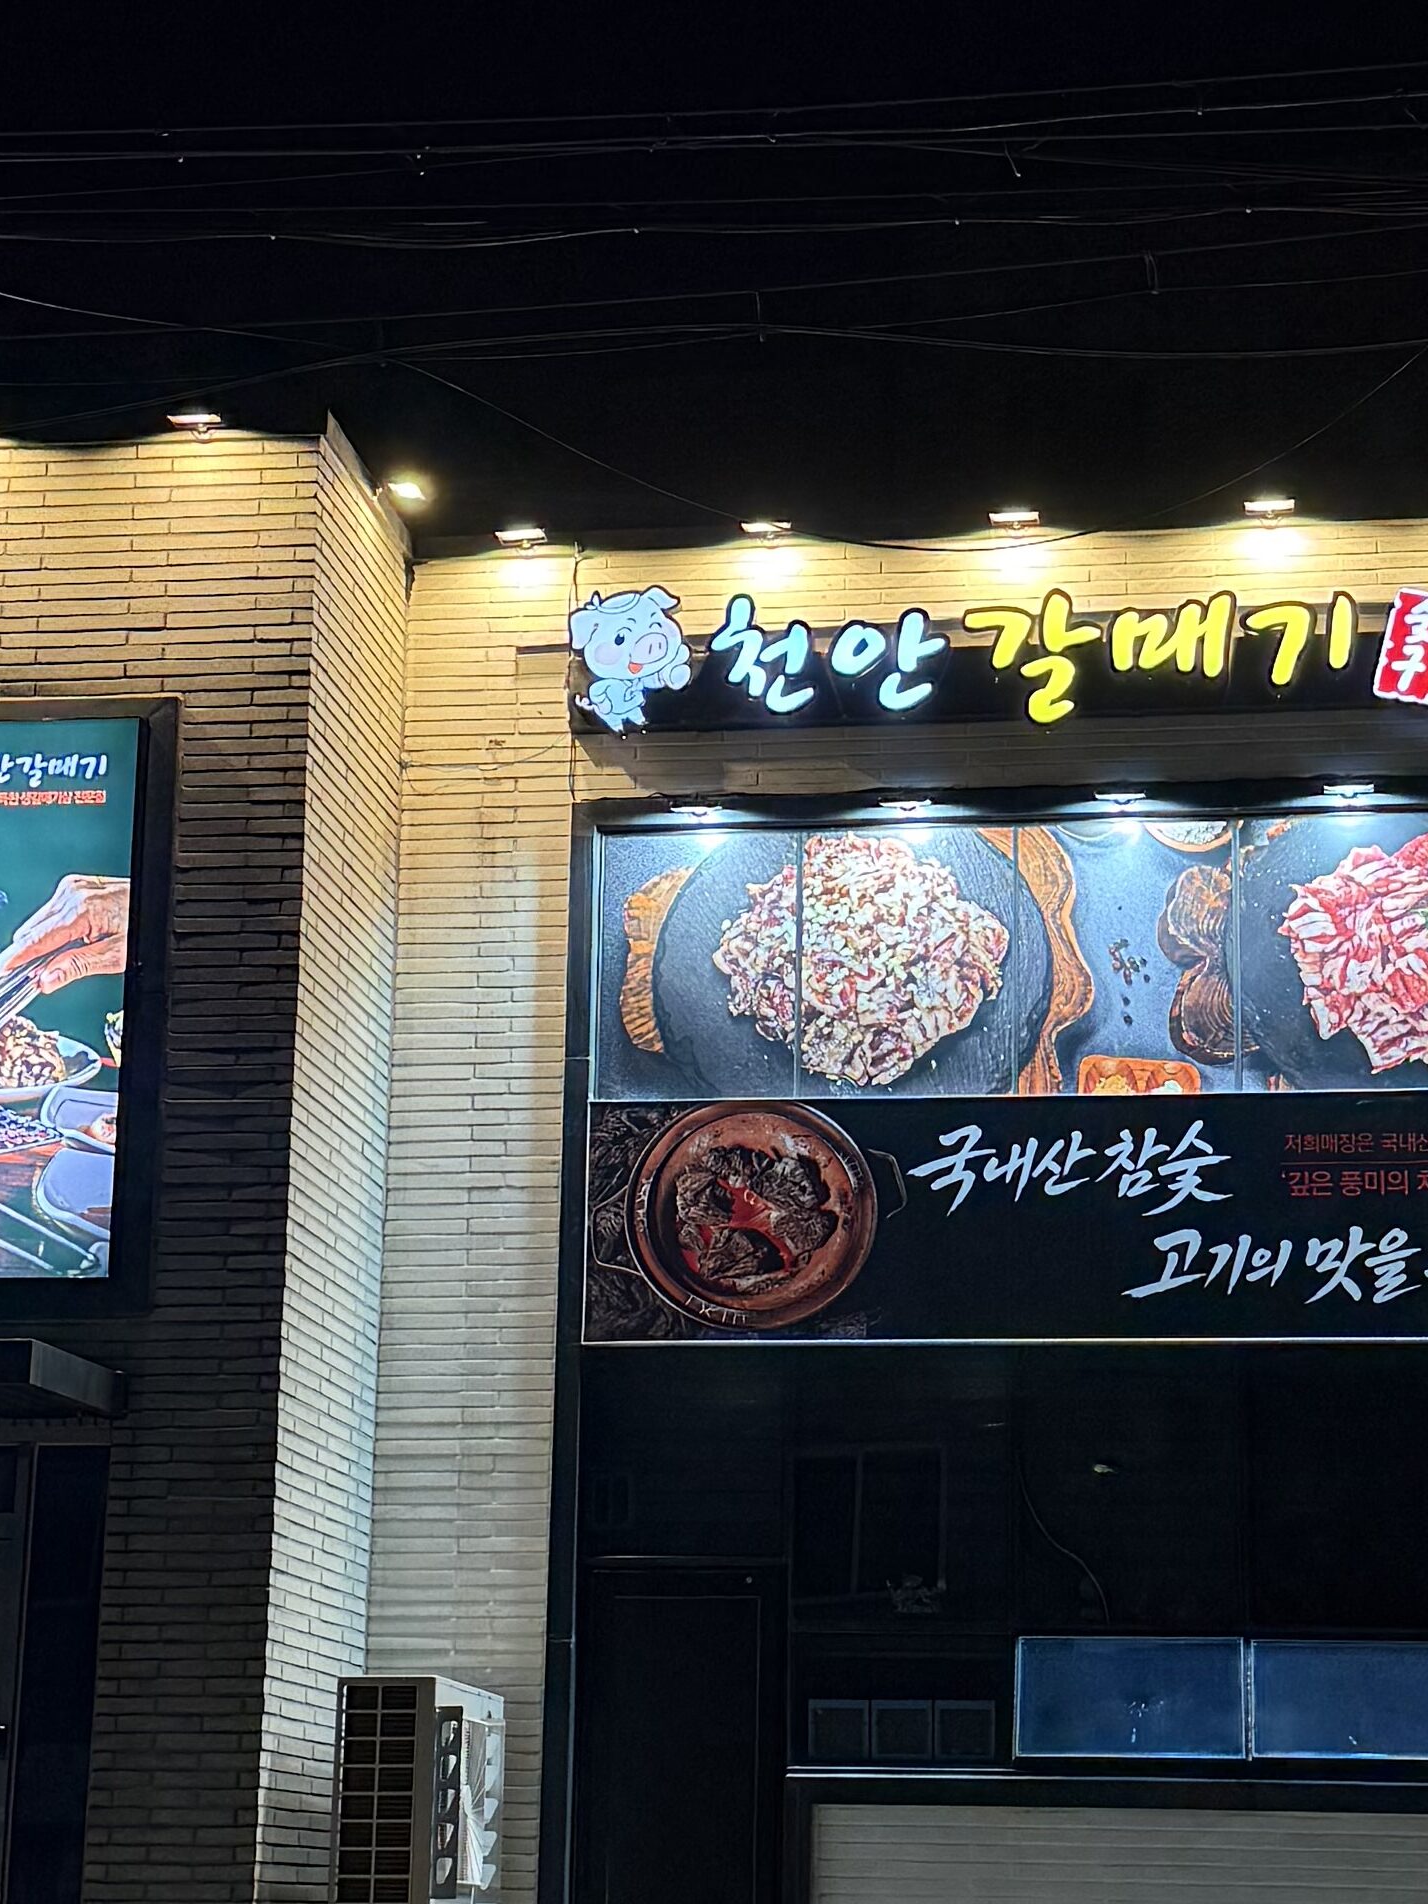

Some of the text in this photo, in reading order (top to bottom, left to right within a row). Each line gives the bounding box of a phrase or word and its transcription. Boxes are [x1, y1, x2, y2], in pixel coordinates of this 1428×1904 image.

[907, 1119, 1234, 1216] 국내산 참숯
[1284, 1132, 1374, 1153] 저희매장은
[1339, 1169, 1410, 1197] 풍미의
[1121, 1228, 1293, 1299] 고기의
[1304, 1226, 1423, 1304] 맛을
